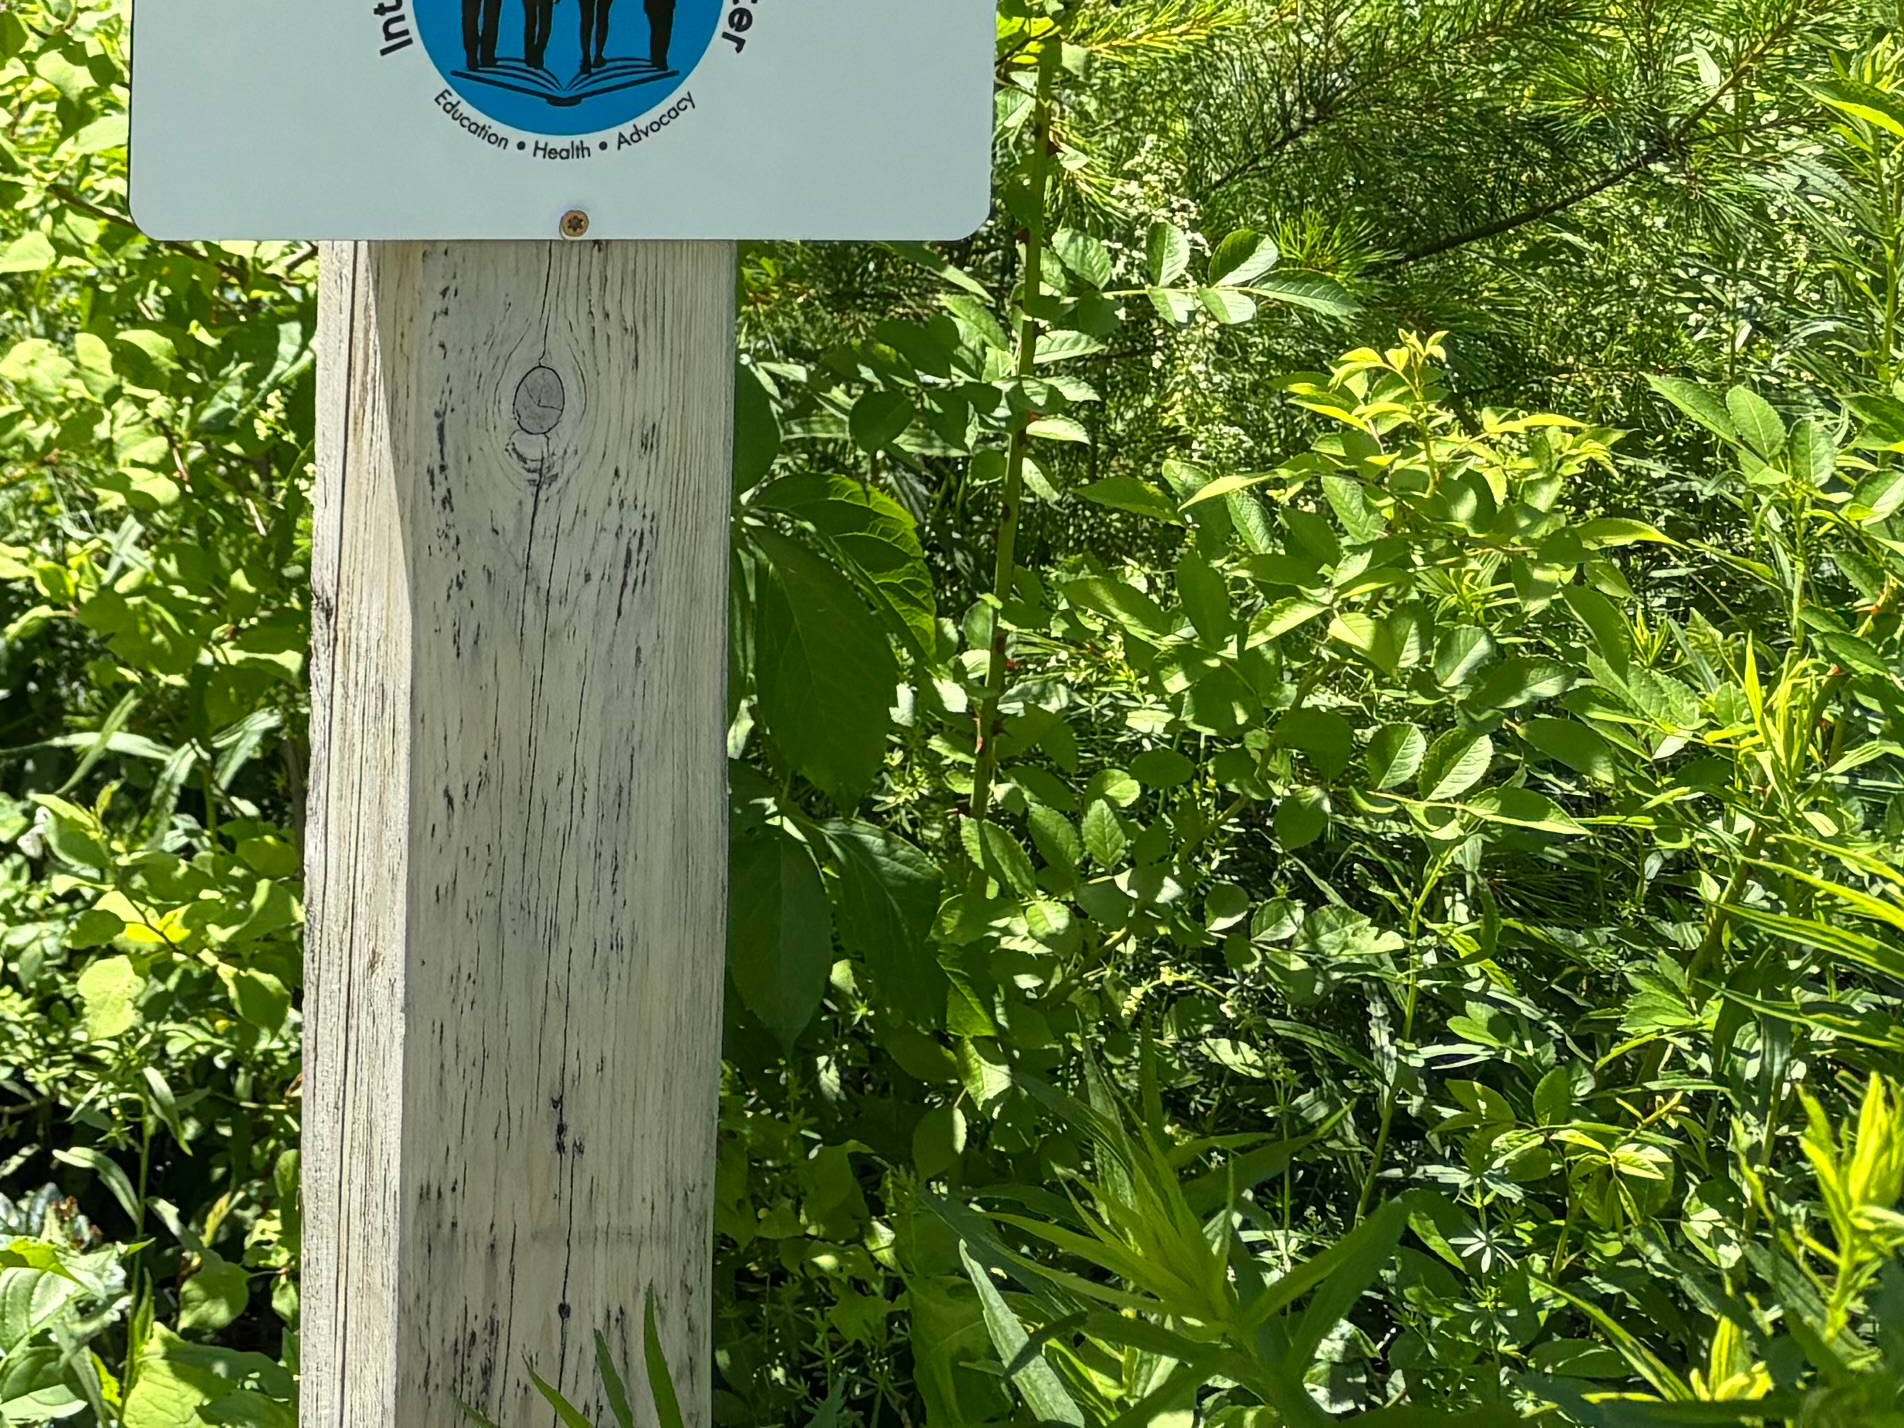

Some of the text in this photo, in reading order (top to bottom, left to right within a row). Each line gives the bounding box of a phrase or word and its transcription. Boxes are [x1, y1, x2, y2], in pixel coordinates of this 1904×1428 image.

[433, 89, 697, 161] Education Health Advocacy
